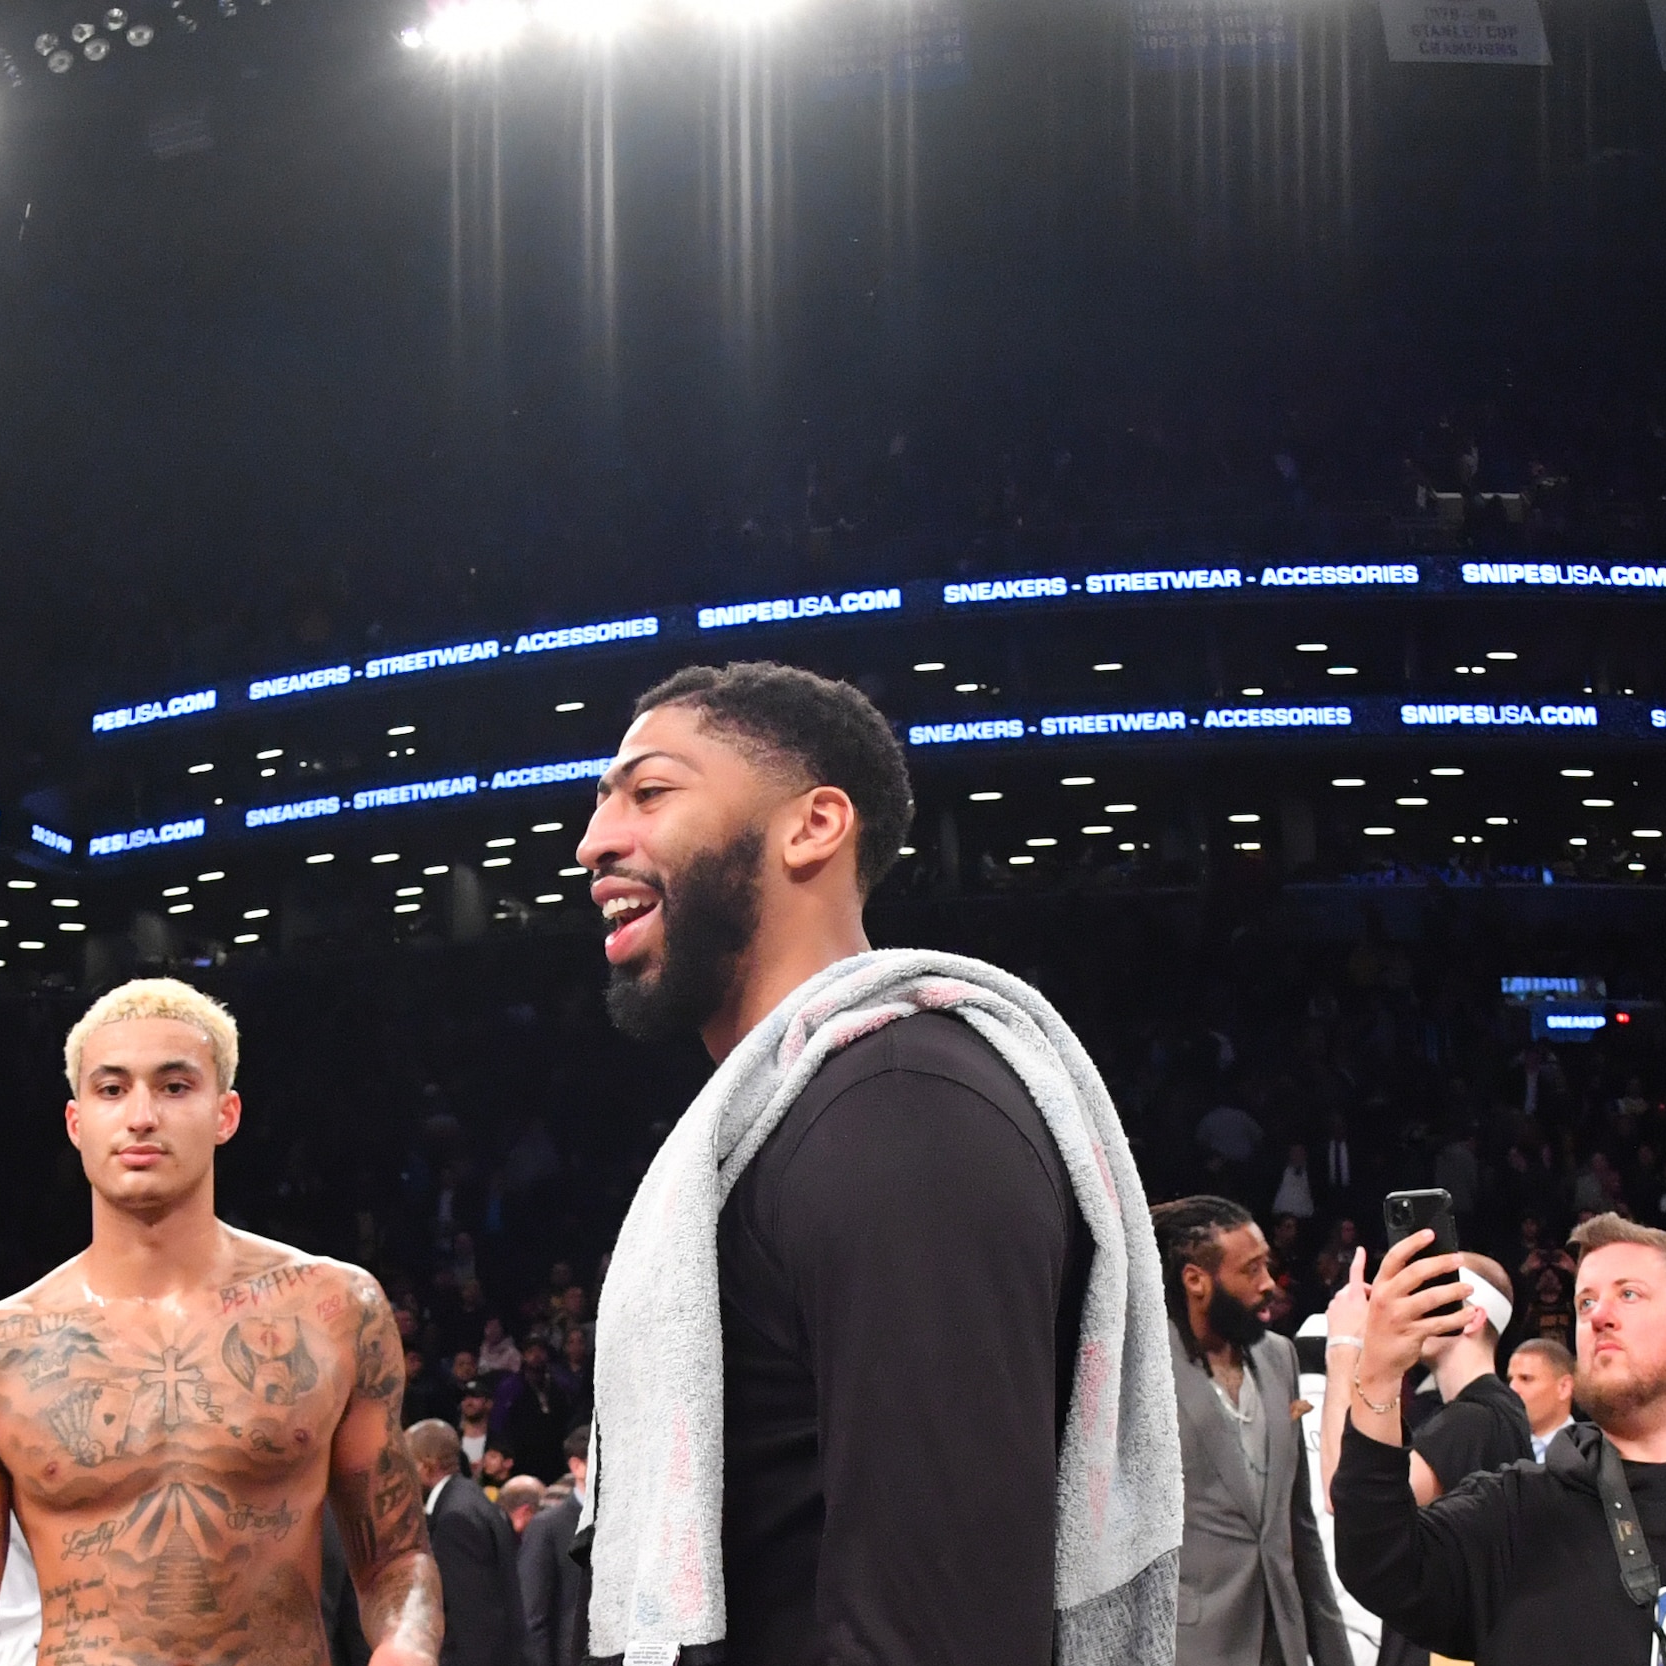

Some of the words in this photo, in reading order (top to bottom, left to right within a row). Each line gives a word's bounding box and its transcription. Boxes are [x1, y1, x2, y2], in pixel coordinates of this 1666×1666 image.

[943, 576, 1068, 604] SNEAKERS
[1085, 568, 1242, 594] STREETWEAR
[1260, 564, 1420, 587] ACCESSORIES
[697, 587, 902, 629] SNIPESUSA.COM
[248, 664, 352, 701] SNEAKERS
[364, 639, 500, 679] STREETWEAR
[513, 616, 659, 655] ACCESSORIES
[908, 718, 1025, 745] SNEAKERS
[1040, 710, 1187, 736] STREETWEAR
[1202, 706, 1352, 729] ACCESSORIES
[1400, 704, 1598, 726] SNIPESUSA.COM
[245, 795, 341, 828] SNEAKERS
[352, 775, 478, 810] STREETWEAR
